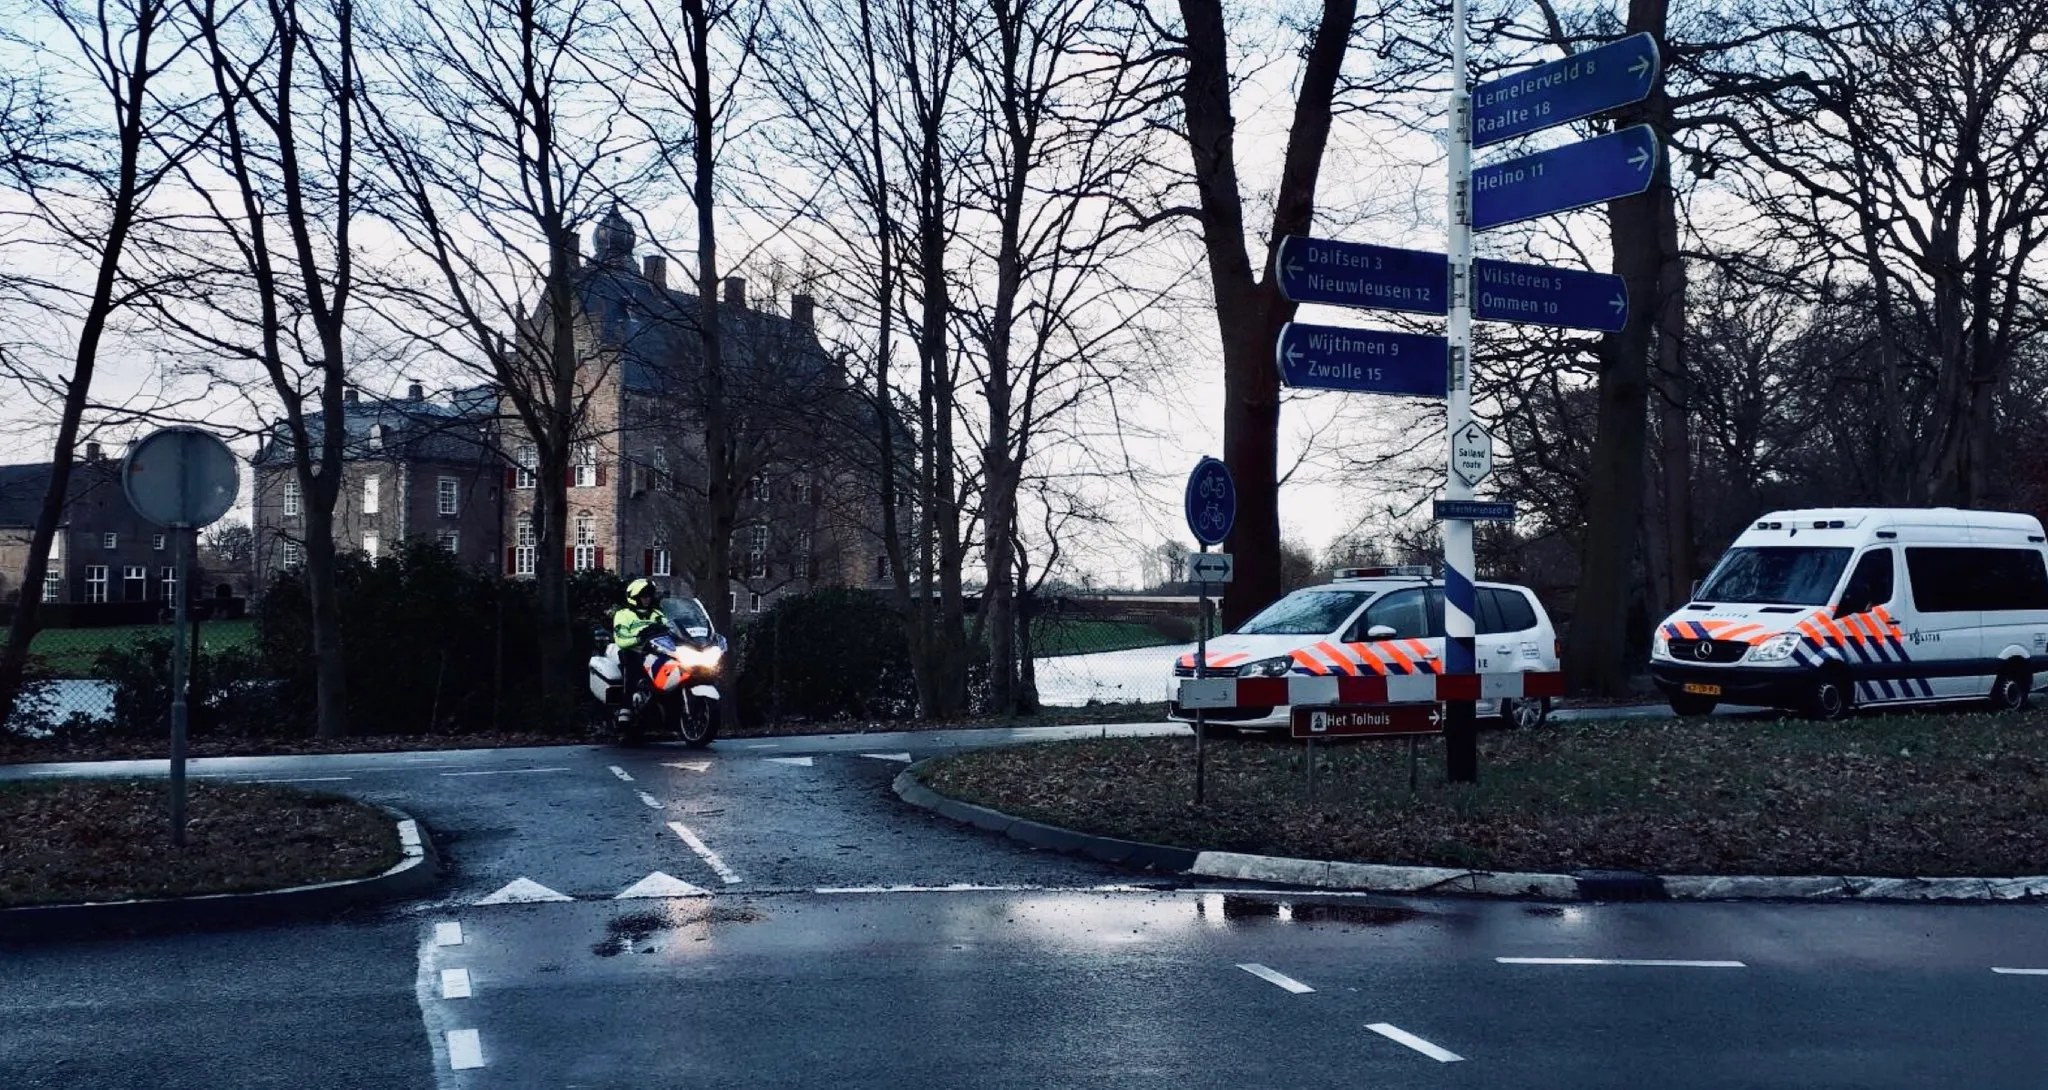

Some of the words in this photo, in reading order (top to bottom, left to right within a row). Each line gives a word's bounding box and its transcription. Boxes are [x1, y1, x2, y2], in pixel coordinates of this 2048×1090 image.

[1477, 61, 1579, 108] Lemelerveld
[1586, 60, 1597, 75] 8
[1477, 107, 1529, 134] Raalte
[1534, 101, 1551, 118] 18
[1477, 167, 1525, 192] Heino
[1531, 162, 1544, 178] 11
[1308, 247, 1370, 269] Dalfsen
[1375, 256, 1383, 270] 3
[1308, 273, 1411, 300] Nieuwleusen
[1415, 287, 1431, 301] 12
[1483, 266, 1550, 289] Vilsteren
[1554, 278, 1562, 291] 5
[1482, 291, 1538, 313] Ommen
[1543, 301, 1559, 315] 10
[1308, 332, 1386, 356] Wijthmen
[1390, 342, 1400, 357] 9
[1308, 360, 1361, 380] Zwolle
[1366, 367, 1383, 381] 15
[1462, 460, 1482, 469] route
[1327, 713, 1347, 726] Het
[1351, 711, 1390, 726] Tolhuis
